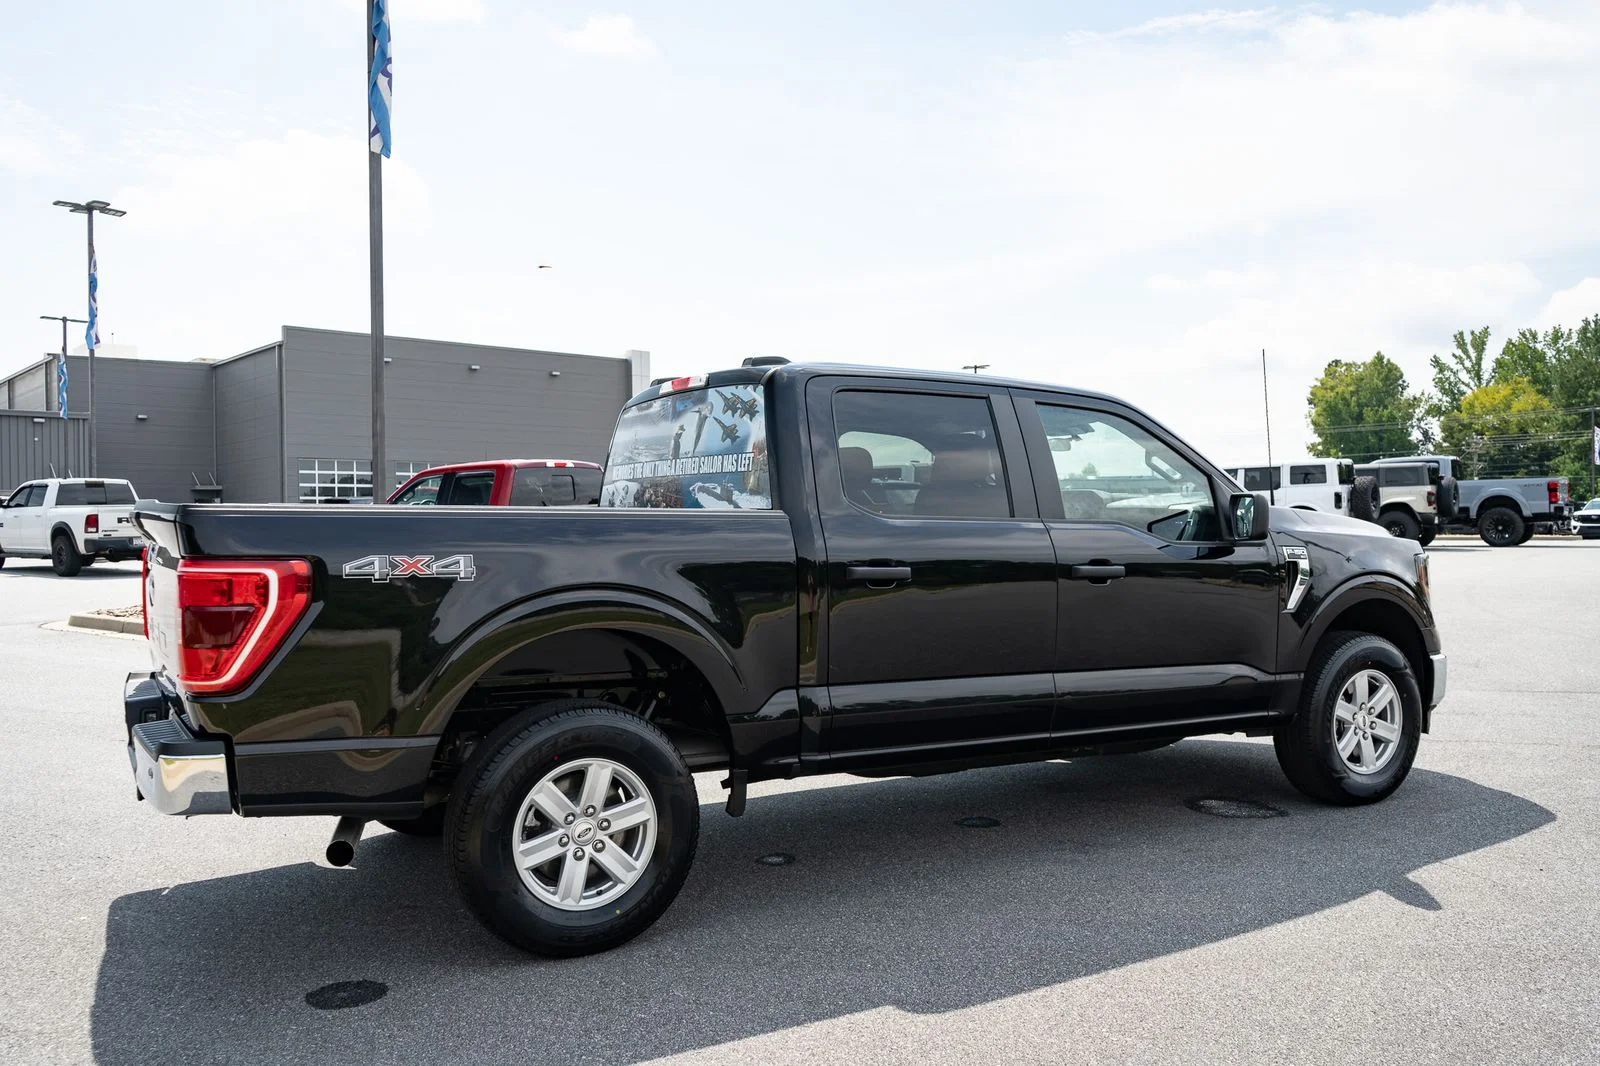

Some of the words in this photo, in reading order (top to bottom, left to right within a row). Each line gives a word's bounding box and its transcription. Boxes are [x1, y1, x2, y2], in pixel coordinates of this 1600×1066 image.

[676, 457, 699, 474] RETIRED
[700, 455, 722, 474] SAILOR
[722, 454, 737, 473] HAS
[738, 453, 754, 472] LEFT
